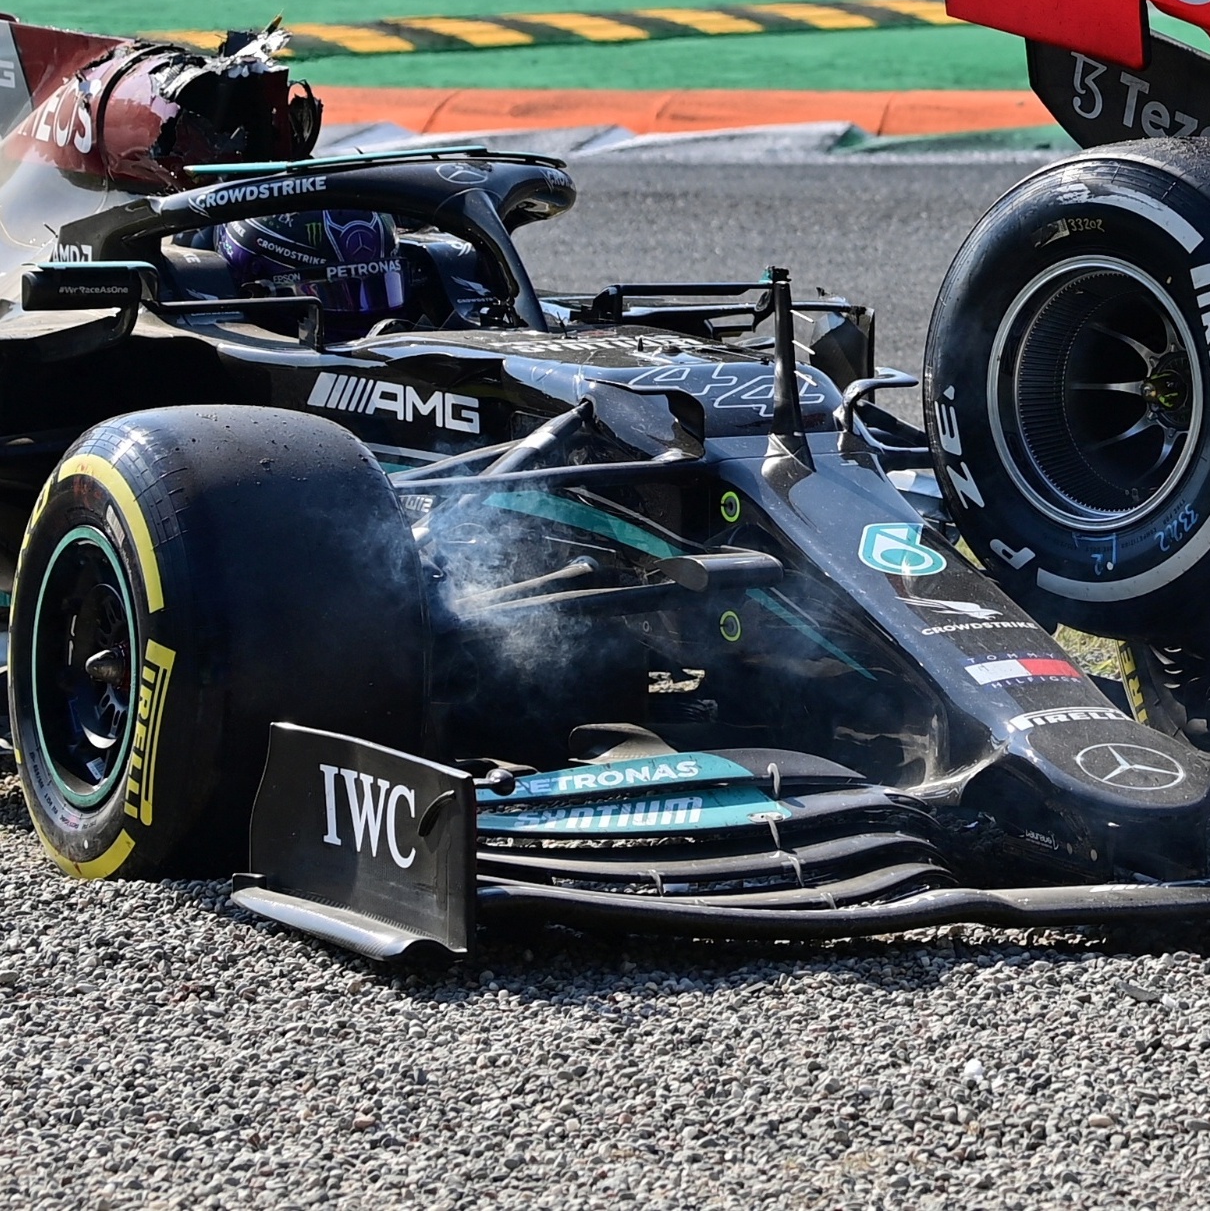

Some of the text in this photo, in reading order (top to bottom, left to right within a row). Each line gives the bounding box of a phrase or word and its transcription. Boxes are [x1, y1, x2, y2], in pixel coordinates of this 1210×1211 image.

[195, 176, 327, 209] CROWDSTRIKE
[256, 238, 327, 265] CROWDSTRIKE
[327, 259, 402, 278] PETRONAS
[365, 380, 480, 435] AMG
[921, 621, 1039, 636] CROWDSTRIKE
[967, 652, 1055, 665] TOMMY
[990, 675, 1082, 690] HILFIGER
[124, 638, 177, 827] PIRELLI
[319, 763, 417, 869] IWC
